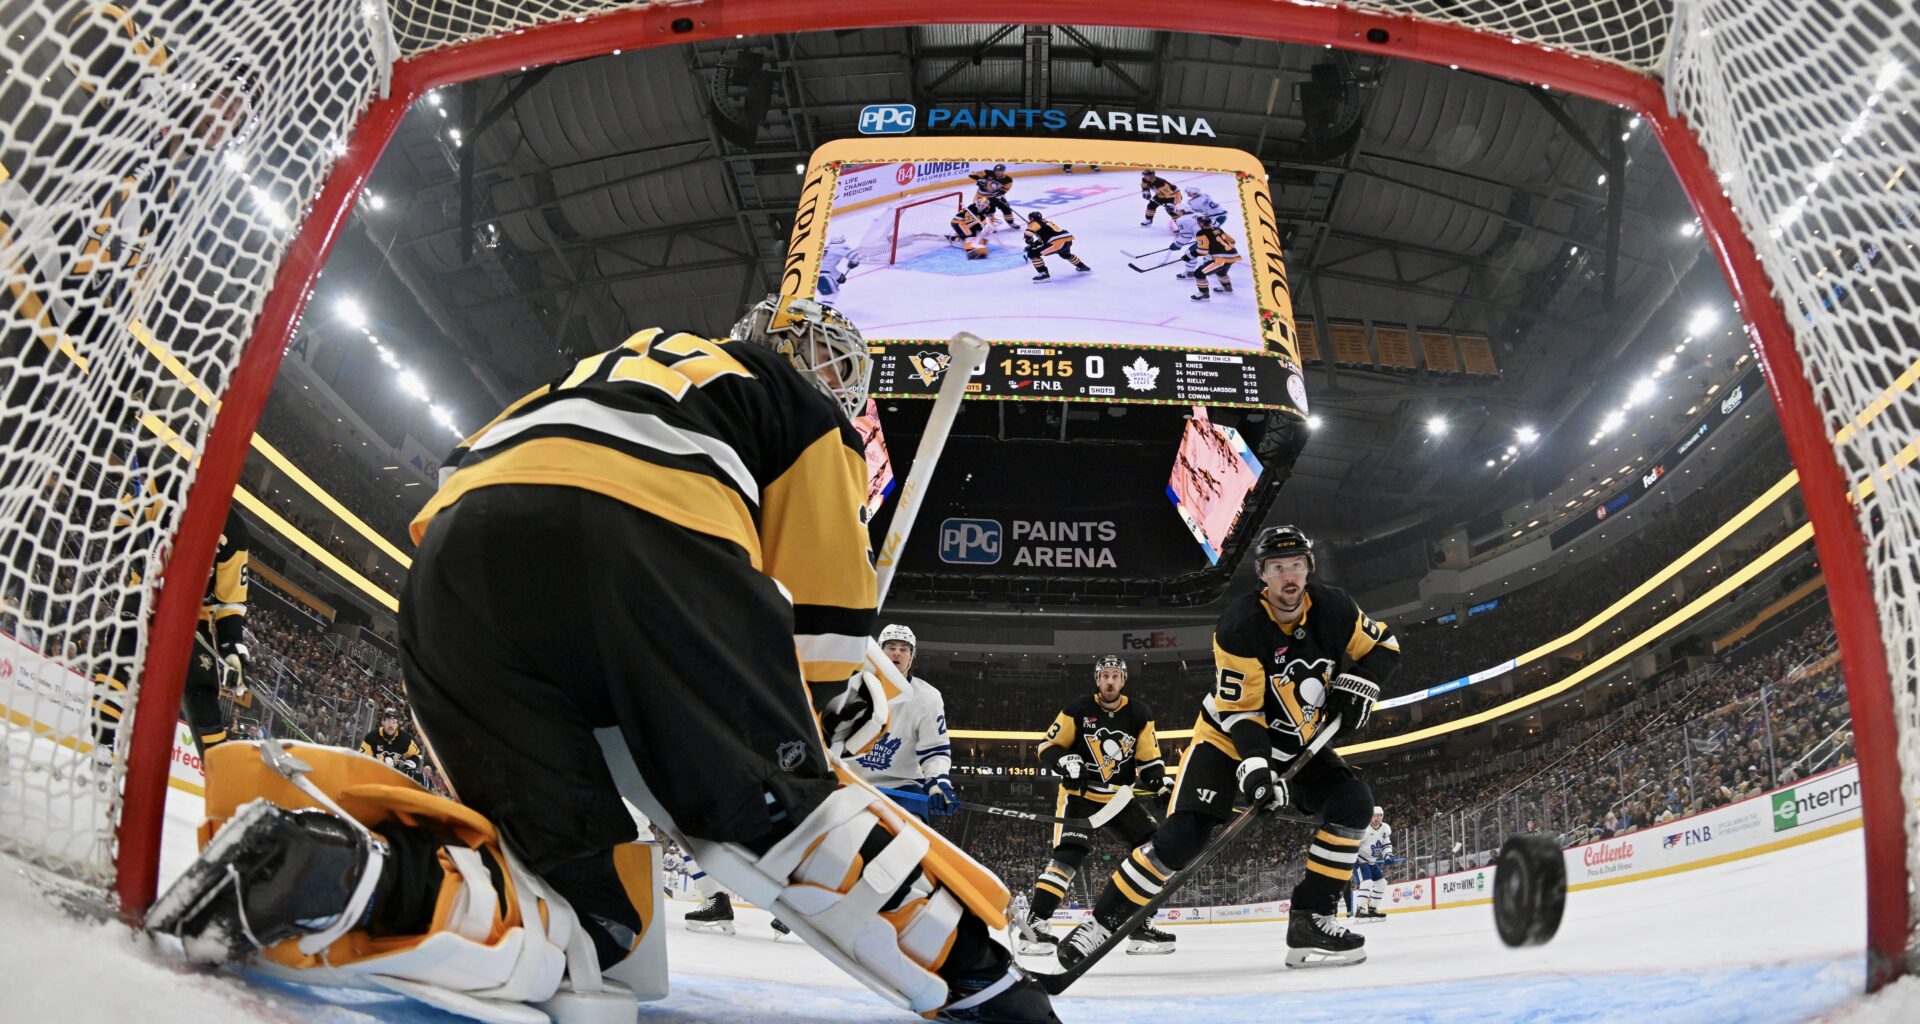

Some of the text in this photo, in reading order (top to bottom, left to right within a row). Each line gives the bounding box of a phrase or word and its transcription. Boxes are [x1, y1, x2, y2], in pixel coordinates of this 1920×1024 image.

[861, 108, 1217, 138] PPG PAINTS ARENA
[844, 176, 859, 185] LIFE
[844, 178, 877, 191] CHANGING
[843, 185, 873, 198] MEDICINE
[1000, 359, 1073, 377] 13:15
[1086, 355, 1105, 379] 0
[1033, 380, 1063, 391] F.N.B.
[1080, 386, 1086, 394] 0
[1643, 464, 1665, 489] FedEx
[942, 520, 1117, 560] PPG PAINTS
[1012, 546, 1117, 569] ARENA
[1122, 631, 1179, 650] FedEx
[1216, 667, 1246, 703] 5
[1335, 676, 1380, 700] WARRIO
[873, 743, 893, 756] ONTO
[863, 756, 885, 764] LEAFS
[997, 767, 1047, 776] 0 13:15 0
[988, 807, 1037, 820] CCM
[1061, 832, 1088, 840] BAUER
[1685, 825, 1713, 847] F.N.B.
[1584, 841, 1634, 867] Caliente
[1443, 881, 1456, 893] PLAY
[1461, 878, 1475, 890] WIN!
